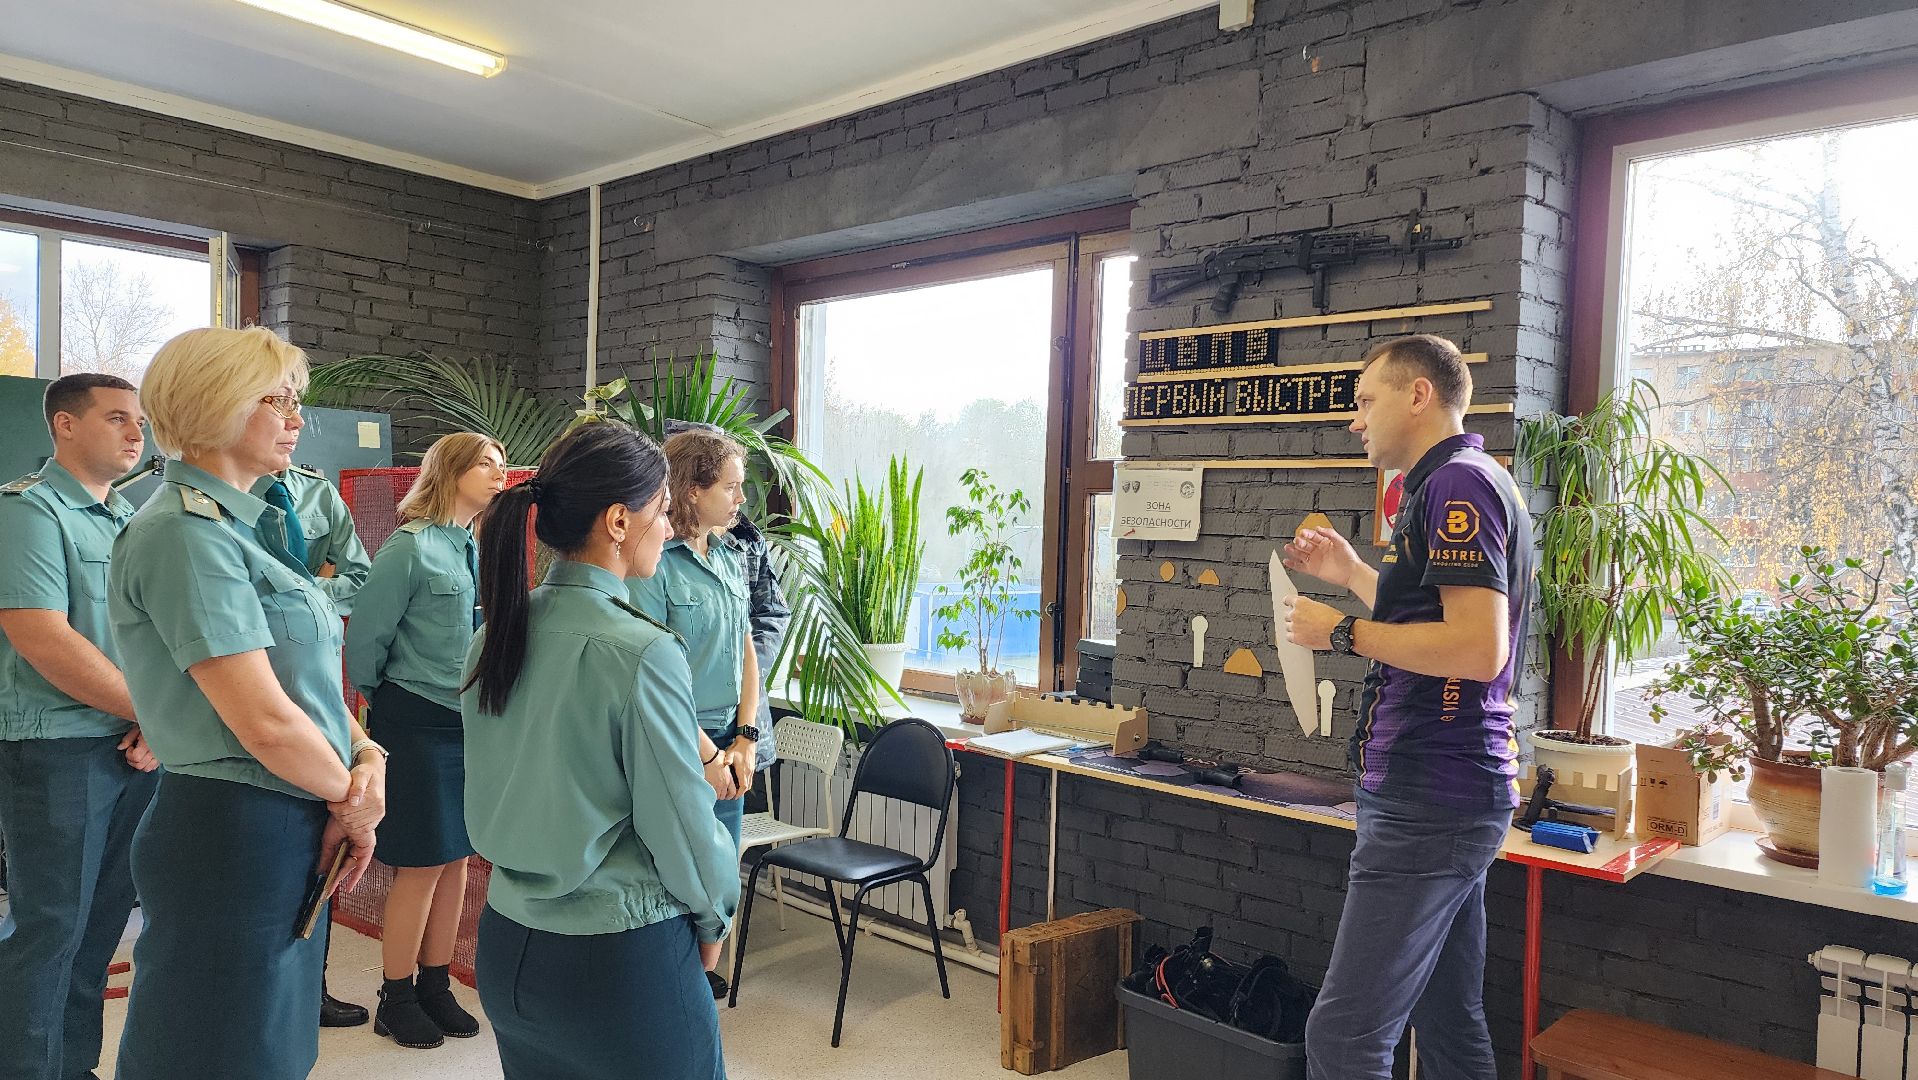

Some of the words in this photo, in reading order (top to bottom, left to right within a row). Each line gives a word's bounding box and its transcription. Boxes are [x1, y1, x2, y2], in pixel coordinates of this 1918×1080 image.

[1125, 378, 1225, 416] ПЕРВЫЙ
[1146, 502, 1171, 510] ЗОНА
[1121, 516, 1192, 528] БЕЗОПАСНОСТИ
[1429, 549, 1485, 562] VISTREL
[1650, 821, 1685, 834] ORM-D
